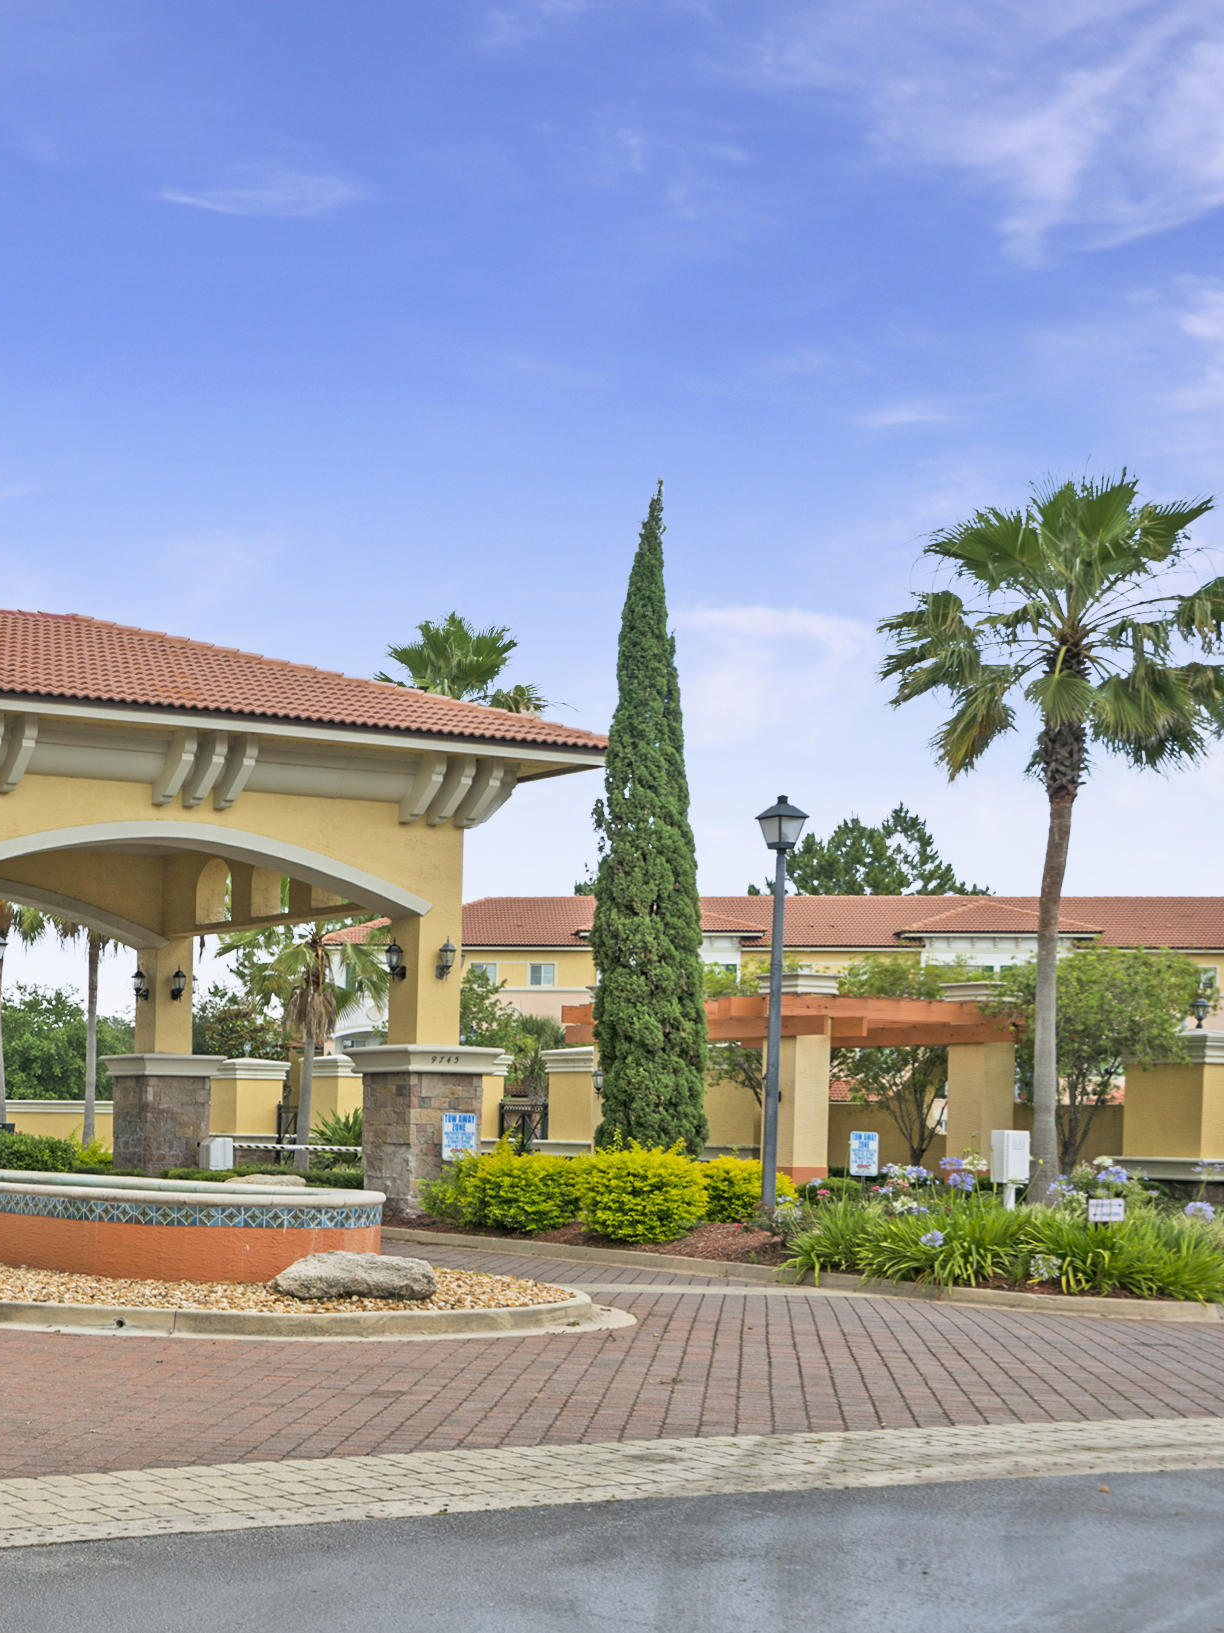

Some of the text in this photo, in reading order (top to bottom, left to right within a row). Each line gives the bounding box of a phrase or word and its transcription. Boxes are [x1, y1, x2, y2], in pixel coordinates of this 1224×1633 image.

[431, 1055, 460, 1064] 9745
[444, 1114, 474, 1123] TOW AWAY
[452, 1123, 465, 1131] ZONE
